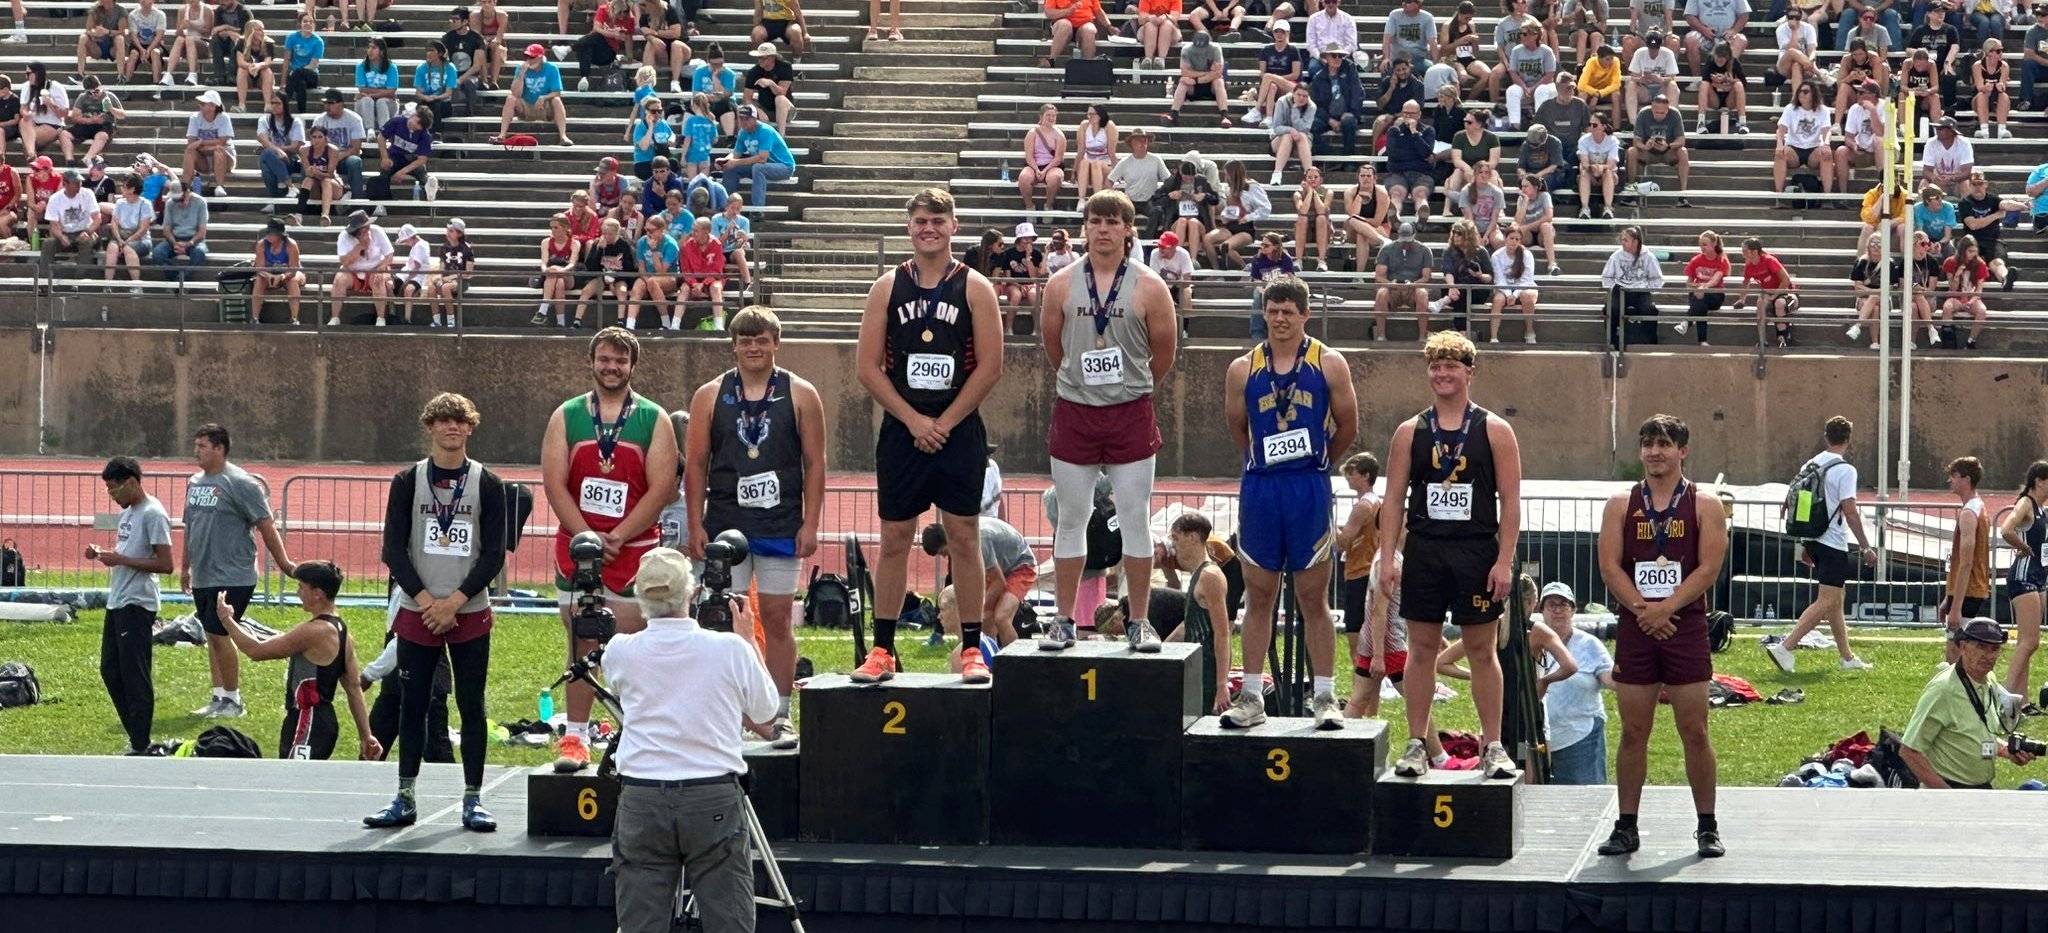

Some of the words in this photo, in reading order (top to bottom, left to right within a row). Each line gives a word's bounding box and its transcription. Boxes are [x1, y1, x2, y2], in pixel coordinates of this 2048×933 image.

[897, 299, 959, 325] LYNON
[911, 362, 951, 378] 2960
[1084, 355, 1120, 373] 3364
[1268, 436, 1307, 457] 2394
[191, 486, 217, 497] TRACK
[585, 484, 623, 505] 3613
[740, 480, 777, 500] 3673
[1431, 491, 1468, 507] 2495
[196, 496, 219, 507] FIELD
[429, 526, 468, 543] 369
[1639, 569, 1677, 585] 2603
[1473, 595, 1490, 612] GP
[1080, 668, 1096, 701] 1
[882, 701, 906, 734] 2
[298, 747, 307, 760] 5
[1265, 748, 1291, 781] 3
[578, 787, 598, 820] 6
[1433, 795, 1454, 828] 5
